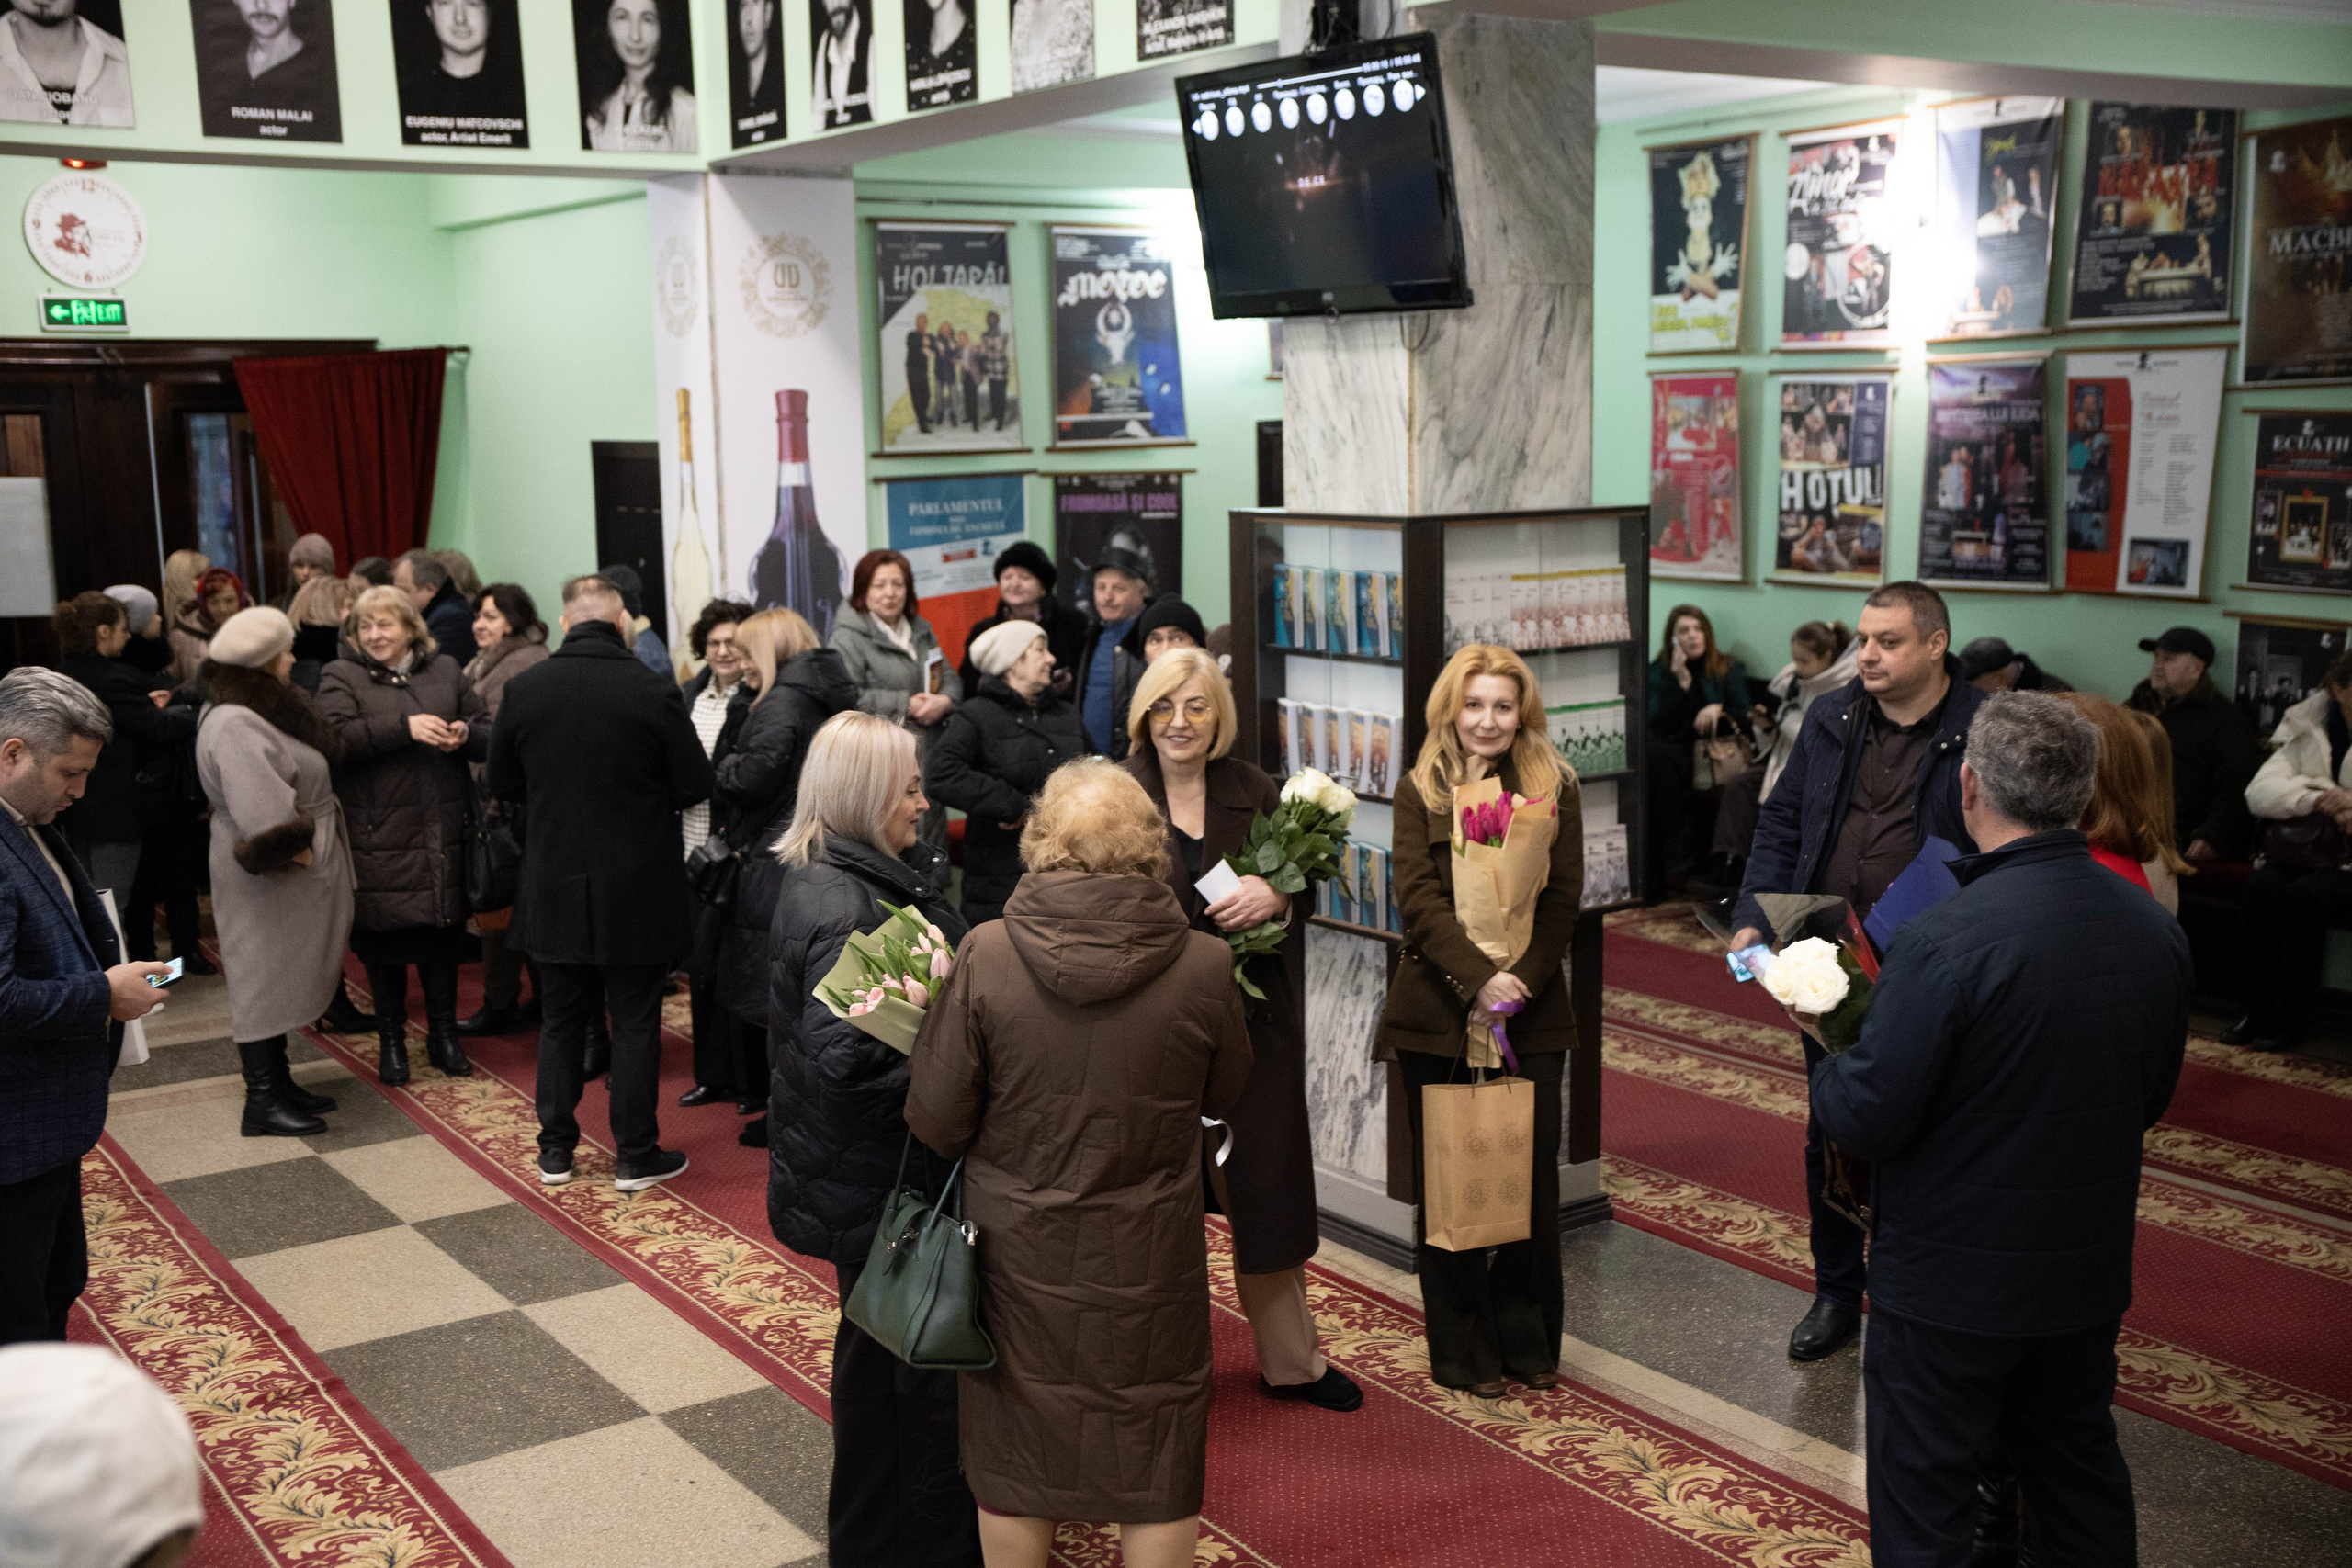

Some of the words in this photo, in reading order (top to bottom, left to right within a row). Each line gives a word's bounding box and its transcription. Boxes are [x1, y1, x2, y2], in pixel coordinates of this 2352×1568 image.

[232, 106, 275, 120] ROMAN
[405, 115, 455, 129] EUGENIU
[259, 124, 288, 136] actor
[81, 178, 96, 193] 12
[85, 273, 94, 283] 6
[908, 498, 1003, 516] PARLAMENTUL
